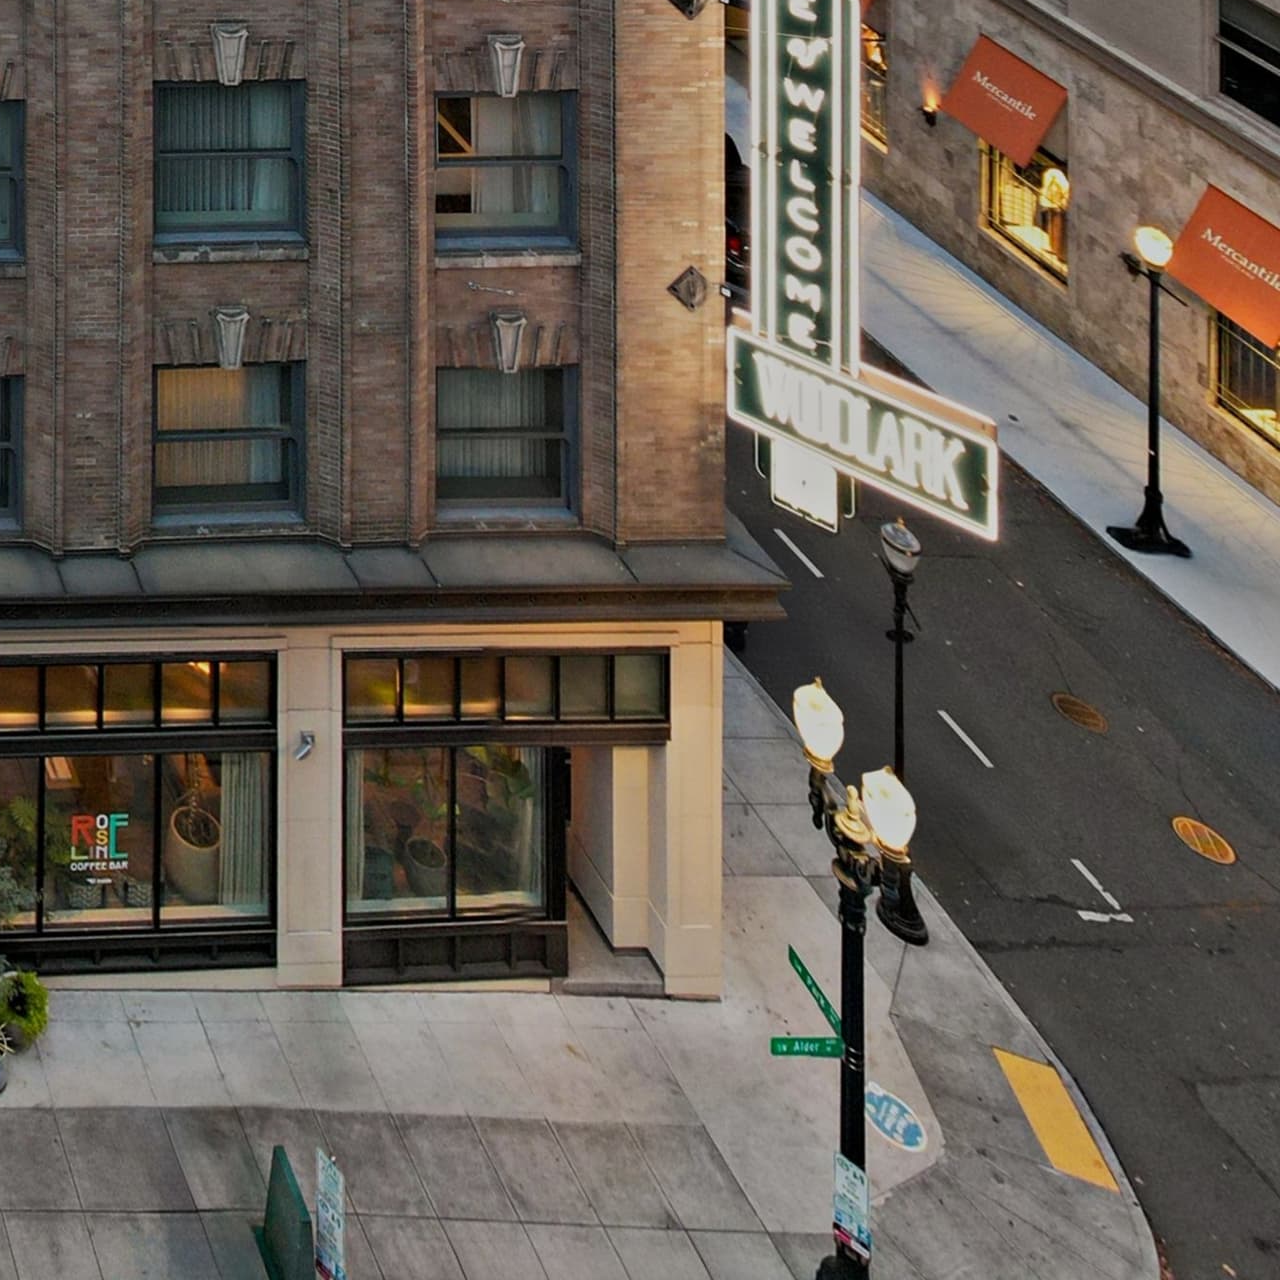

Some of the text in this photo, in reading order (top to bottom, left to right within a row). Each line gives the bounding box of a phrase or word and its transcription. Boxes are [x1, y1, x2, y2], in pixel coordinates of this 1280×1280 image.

[972, 70, 1038, 121] Mercantile
[784, 77, 825, 350] WELCOME
[752, 351, 969, 511] WOODLARK
[70, 861, 128, 871] COFFEE BAR
[793, 1040, 820, 1052] Alder
